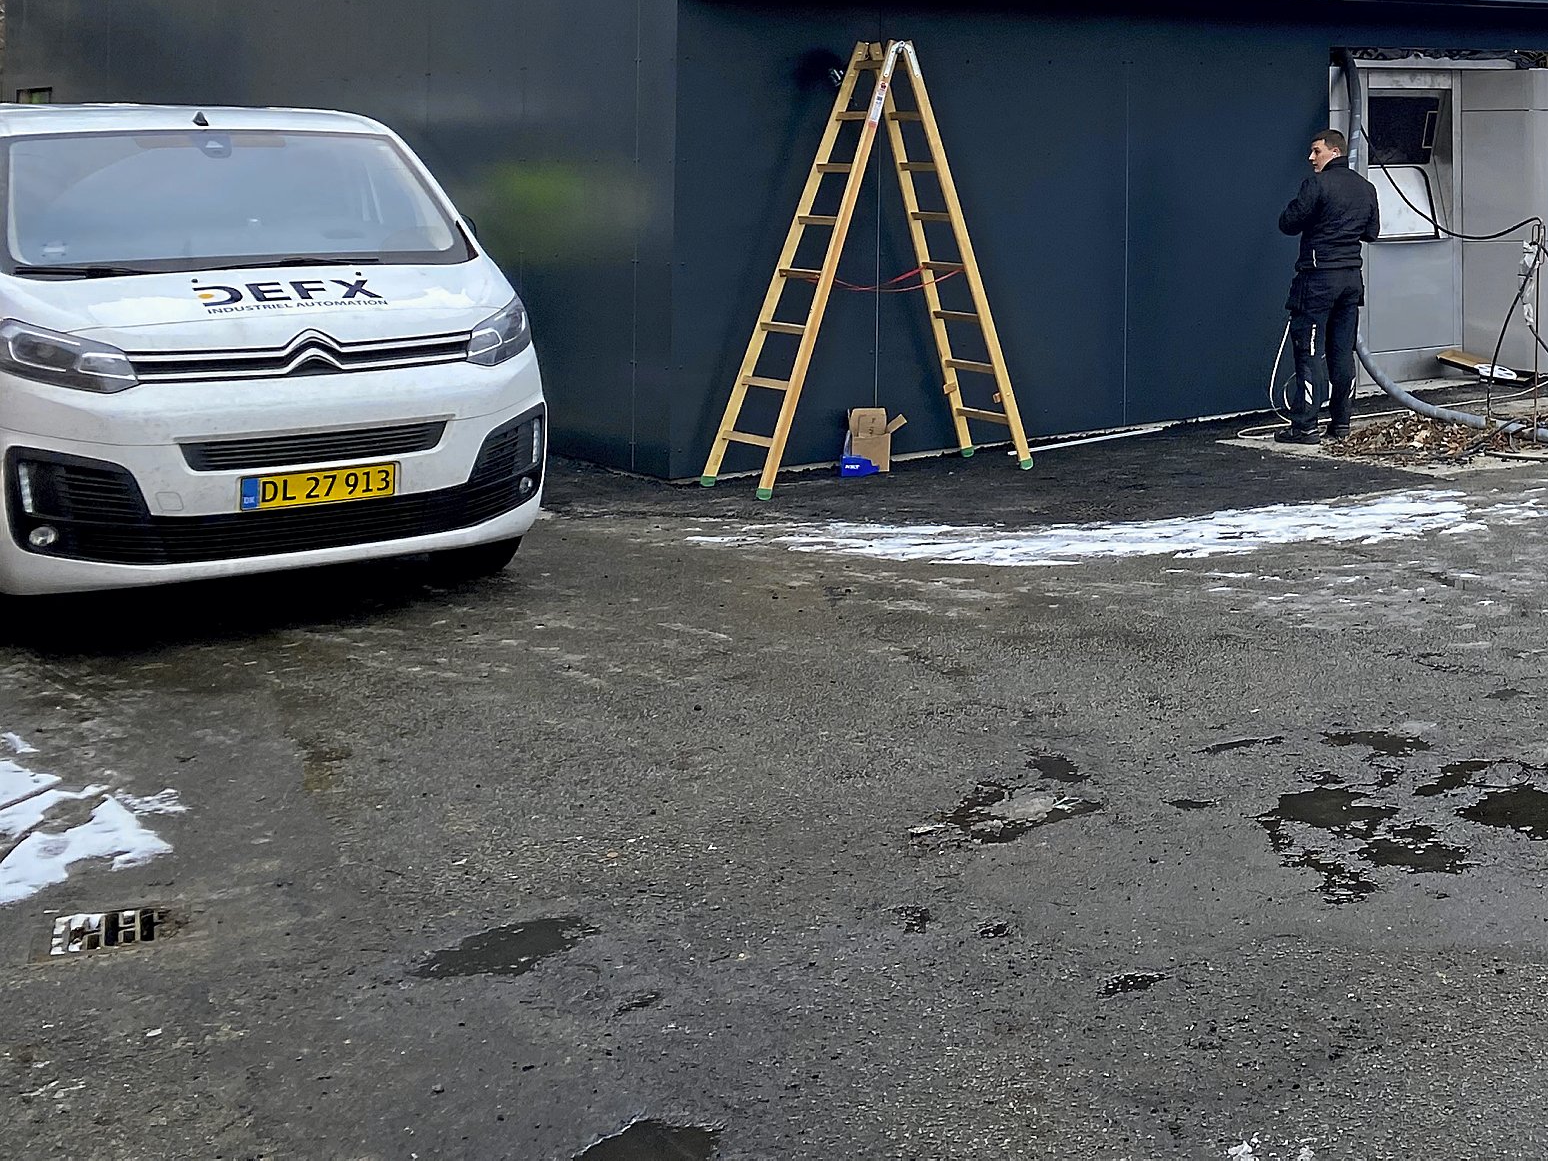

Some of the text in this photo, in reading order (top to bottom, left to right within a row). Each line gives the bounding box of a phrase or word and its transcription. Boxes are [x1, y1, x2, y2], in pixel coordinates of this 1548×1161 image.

[207, 299, 389, 315] INDUSTRIEL AUTOMATION
[261, 469, 390, 503] DL 27 913
